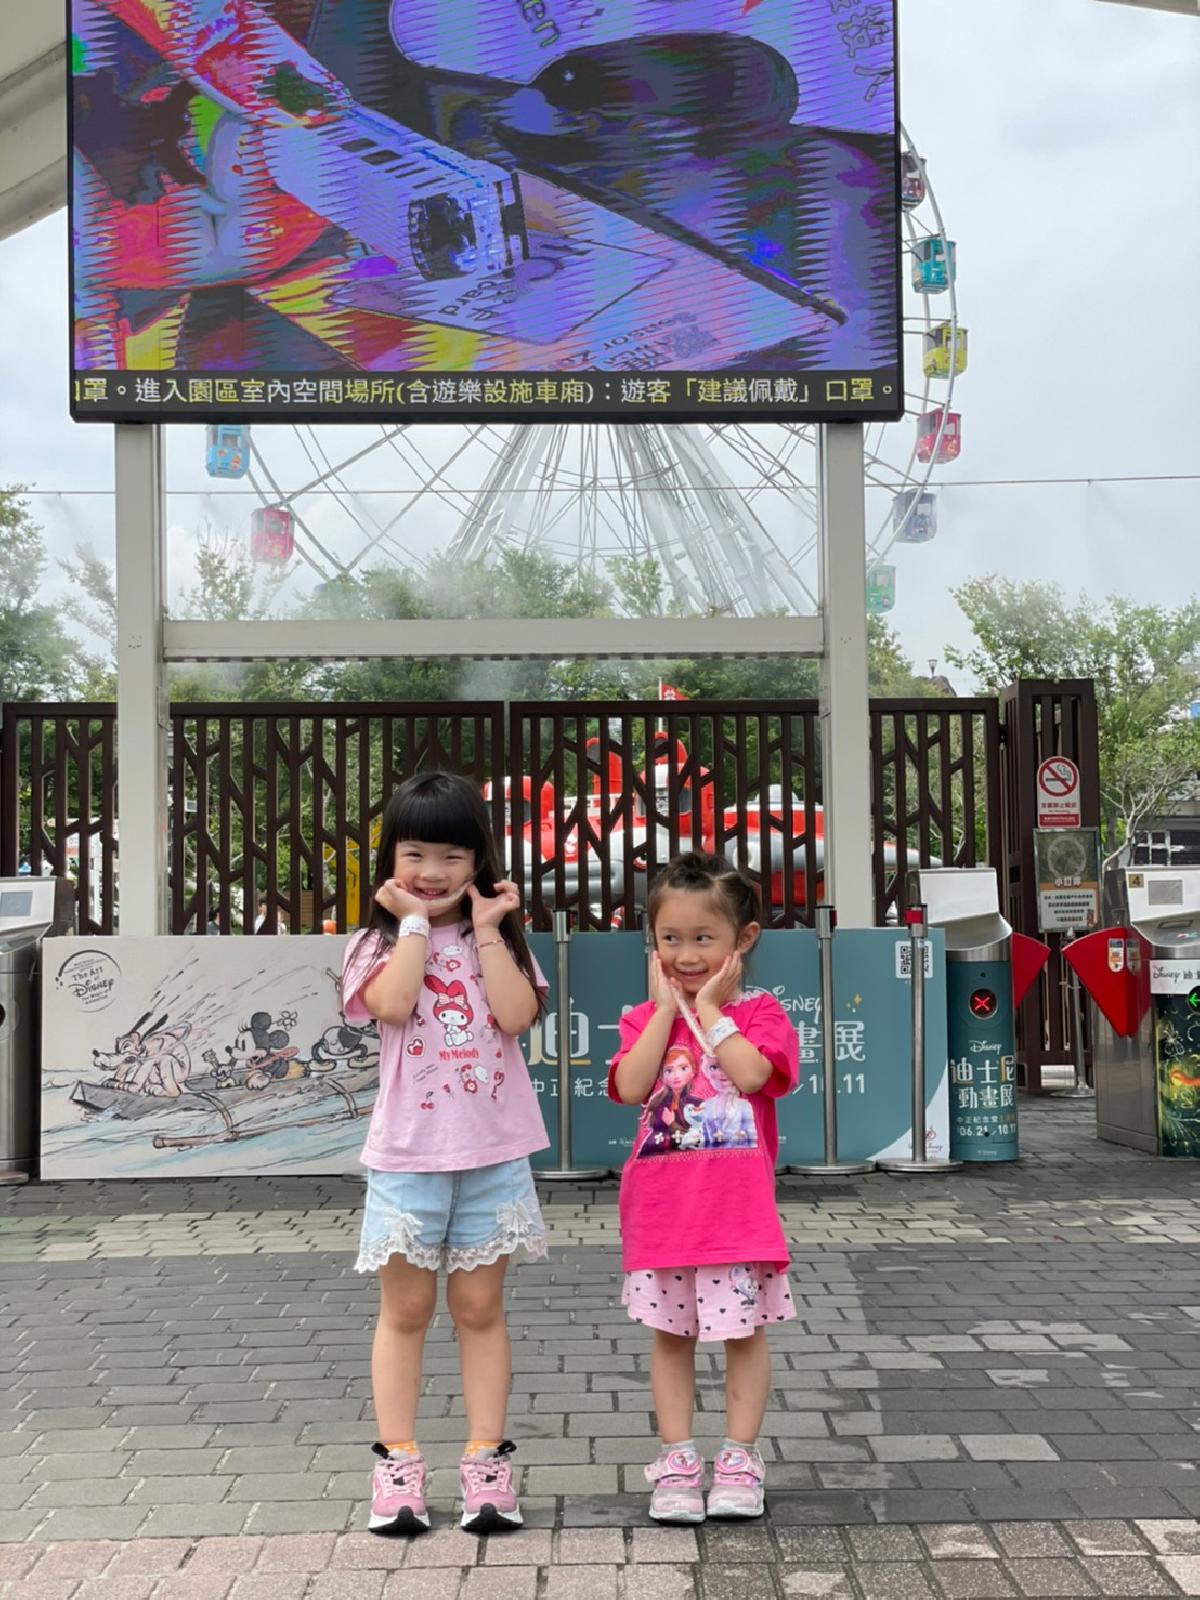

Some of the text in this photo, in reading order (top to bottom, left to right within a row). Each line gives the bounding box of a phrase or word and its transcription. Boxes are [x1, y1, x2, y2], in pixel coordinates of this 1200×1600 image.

[439, 1047, 479, 1061] My Melody
[969, 1040, 1002, 1054] Disney
[950, 1055, 1015, 1084] 迪士尼
[957, 1084, 1014, 1109] 動畫展
